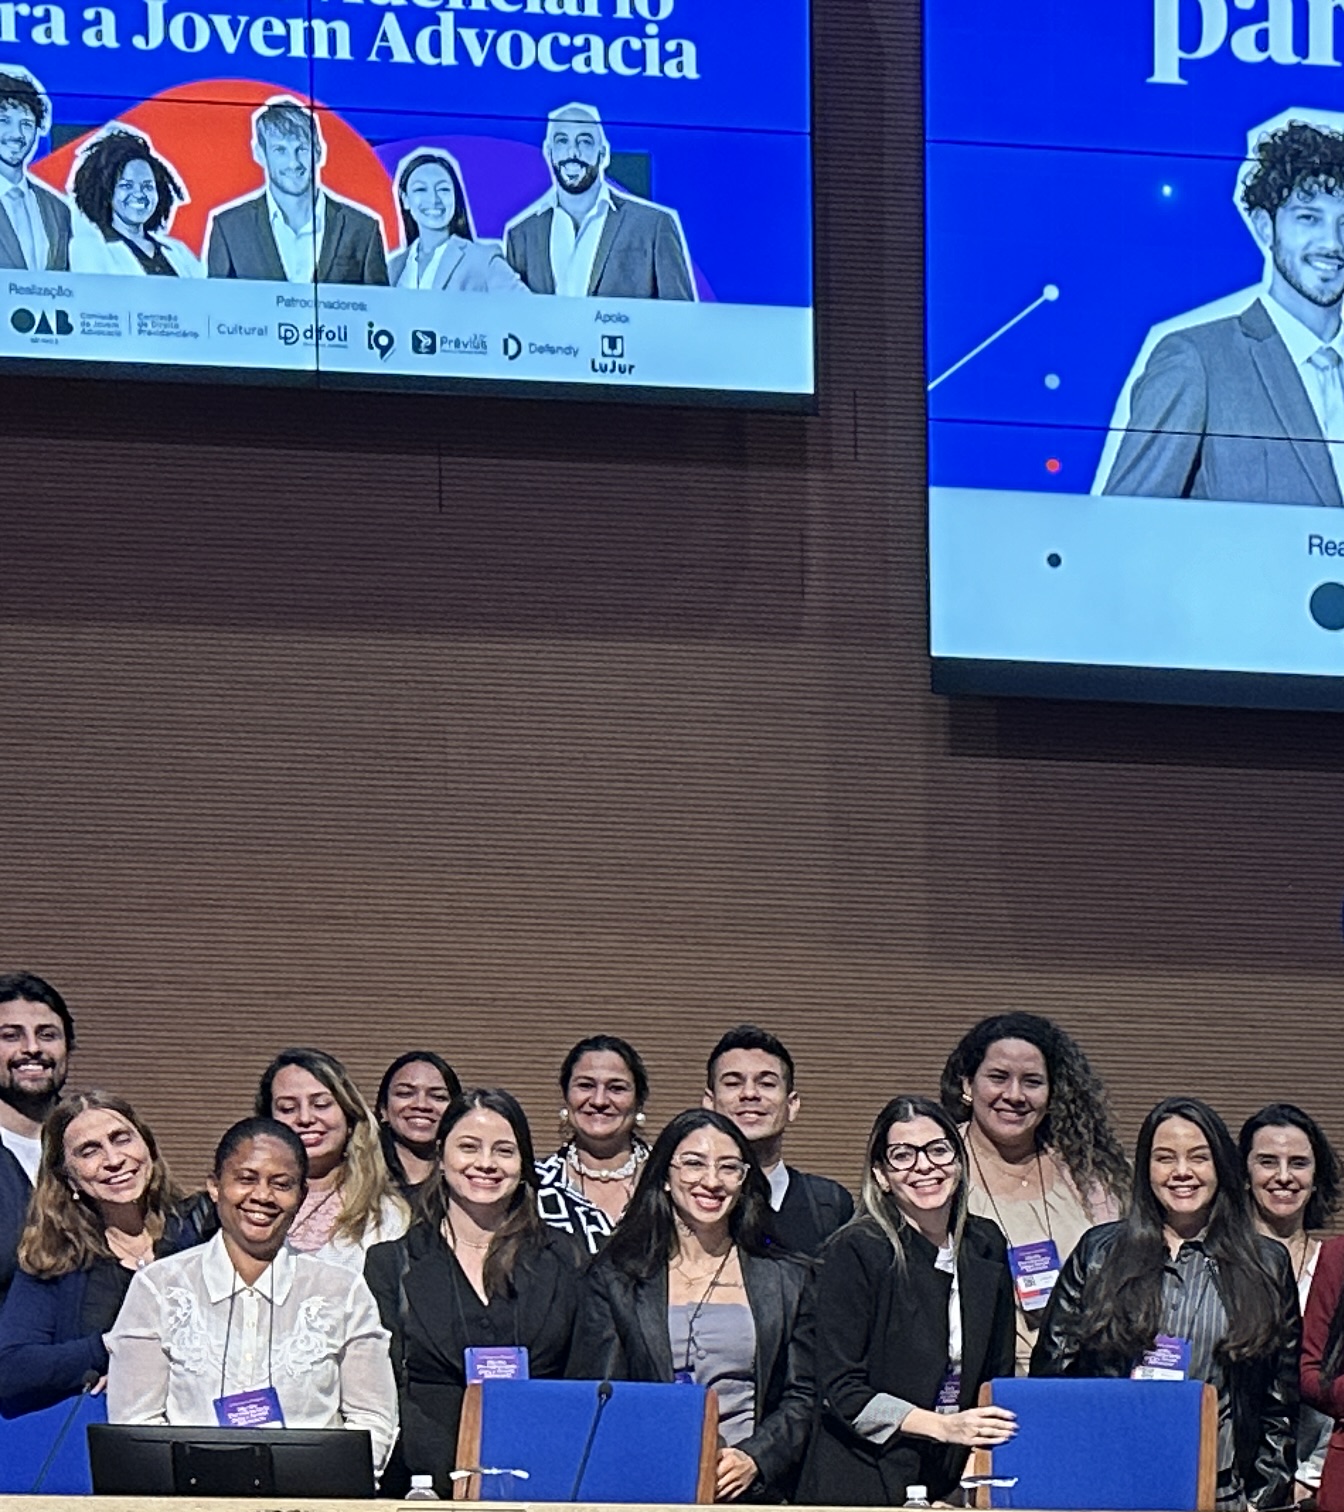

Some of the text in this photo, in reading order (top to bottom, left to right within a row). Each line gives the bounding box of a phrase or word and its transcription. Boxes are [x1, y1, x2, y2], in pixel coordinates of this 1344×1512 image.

[82, 6, 121, 49] a
[132, 0, 354, 61] Jovem
[367, 11, 701, 80] Advocacia
[10, 308, 74, 335] OAB
[217, 323, 268, 337] Cultural
